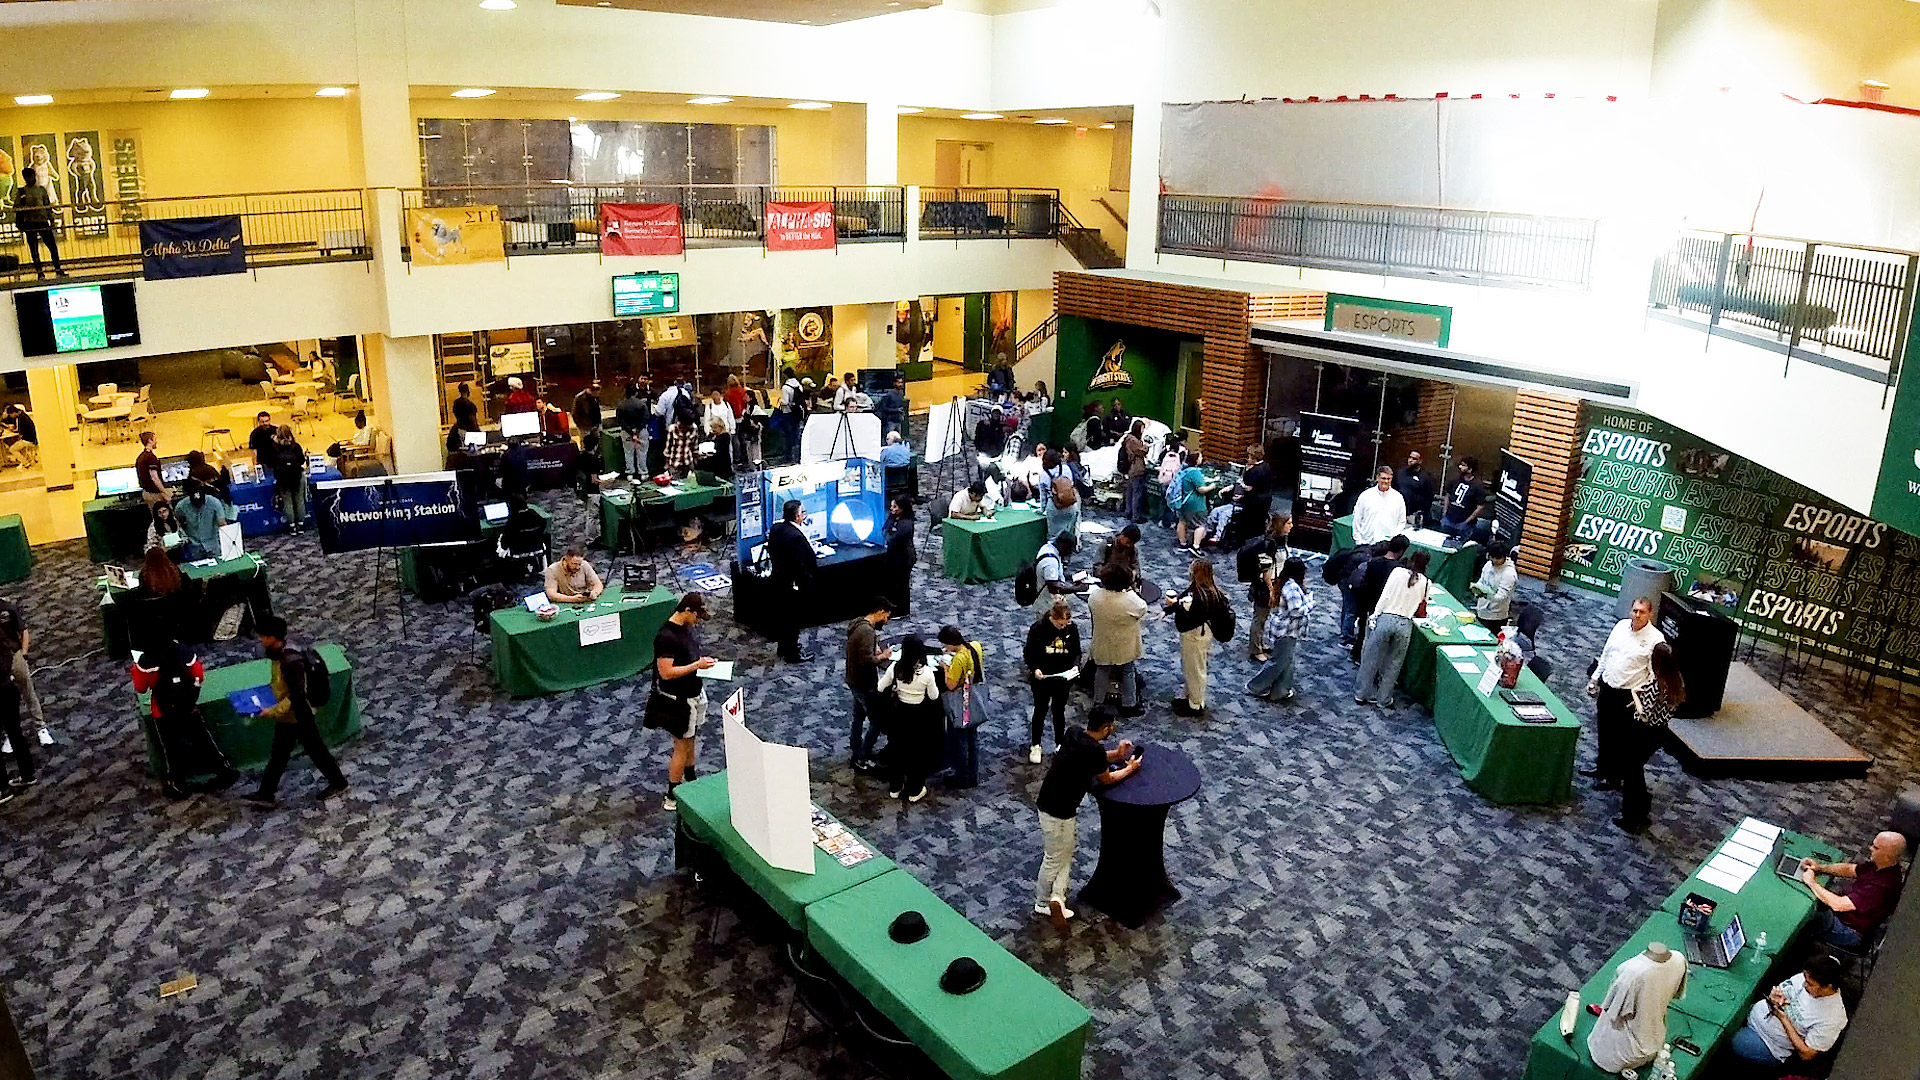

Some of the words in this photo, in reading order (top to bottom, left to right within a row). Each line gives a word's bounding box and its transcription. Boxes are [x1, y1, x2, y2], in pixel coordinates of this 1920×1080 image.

[144, 241, 181, 260] Alpha
[182, 239, 196, 253] Xi
[199, 237, 230, 252] Delta
[1354, 313, 1416, 336] ESPORTS
[1603, 415, 1636, 432] HOME
[1638, 422, 1653, 434] OF
[1582, 428, 1672, 468] ESPORTS
[1573, 484, 1651, 524] SPORTS
[1592, 459, 1684, 501] ESPORTS
[1681, 478, 1779, 523] ESPORTS
[339, 507, 412, 524] Networking
[414, 503, 455, 517] Station
[1575, 513, 1663, 556] ESPORTS
[1783, 502, 1887, 549] ESPORTS
[1691, 512, 1790, 559] ESPORTS
[1663, 535, 1758, 583] ESPORTS
[1756, 558, 1859, 606] ESPORTS
[1744, 588, 1845, 635] ESPORTS
